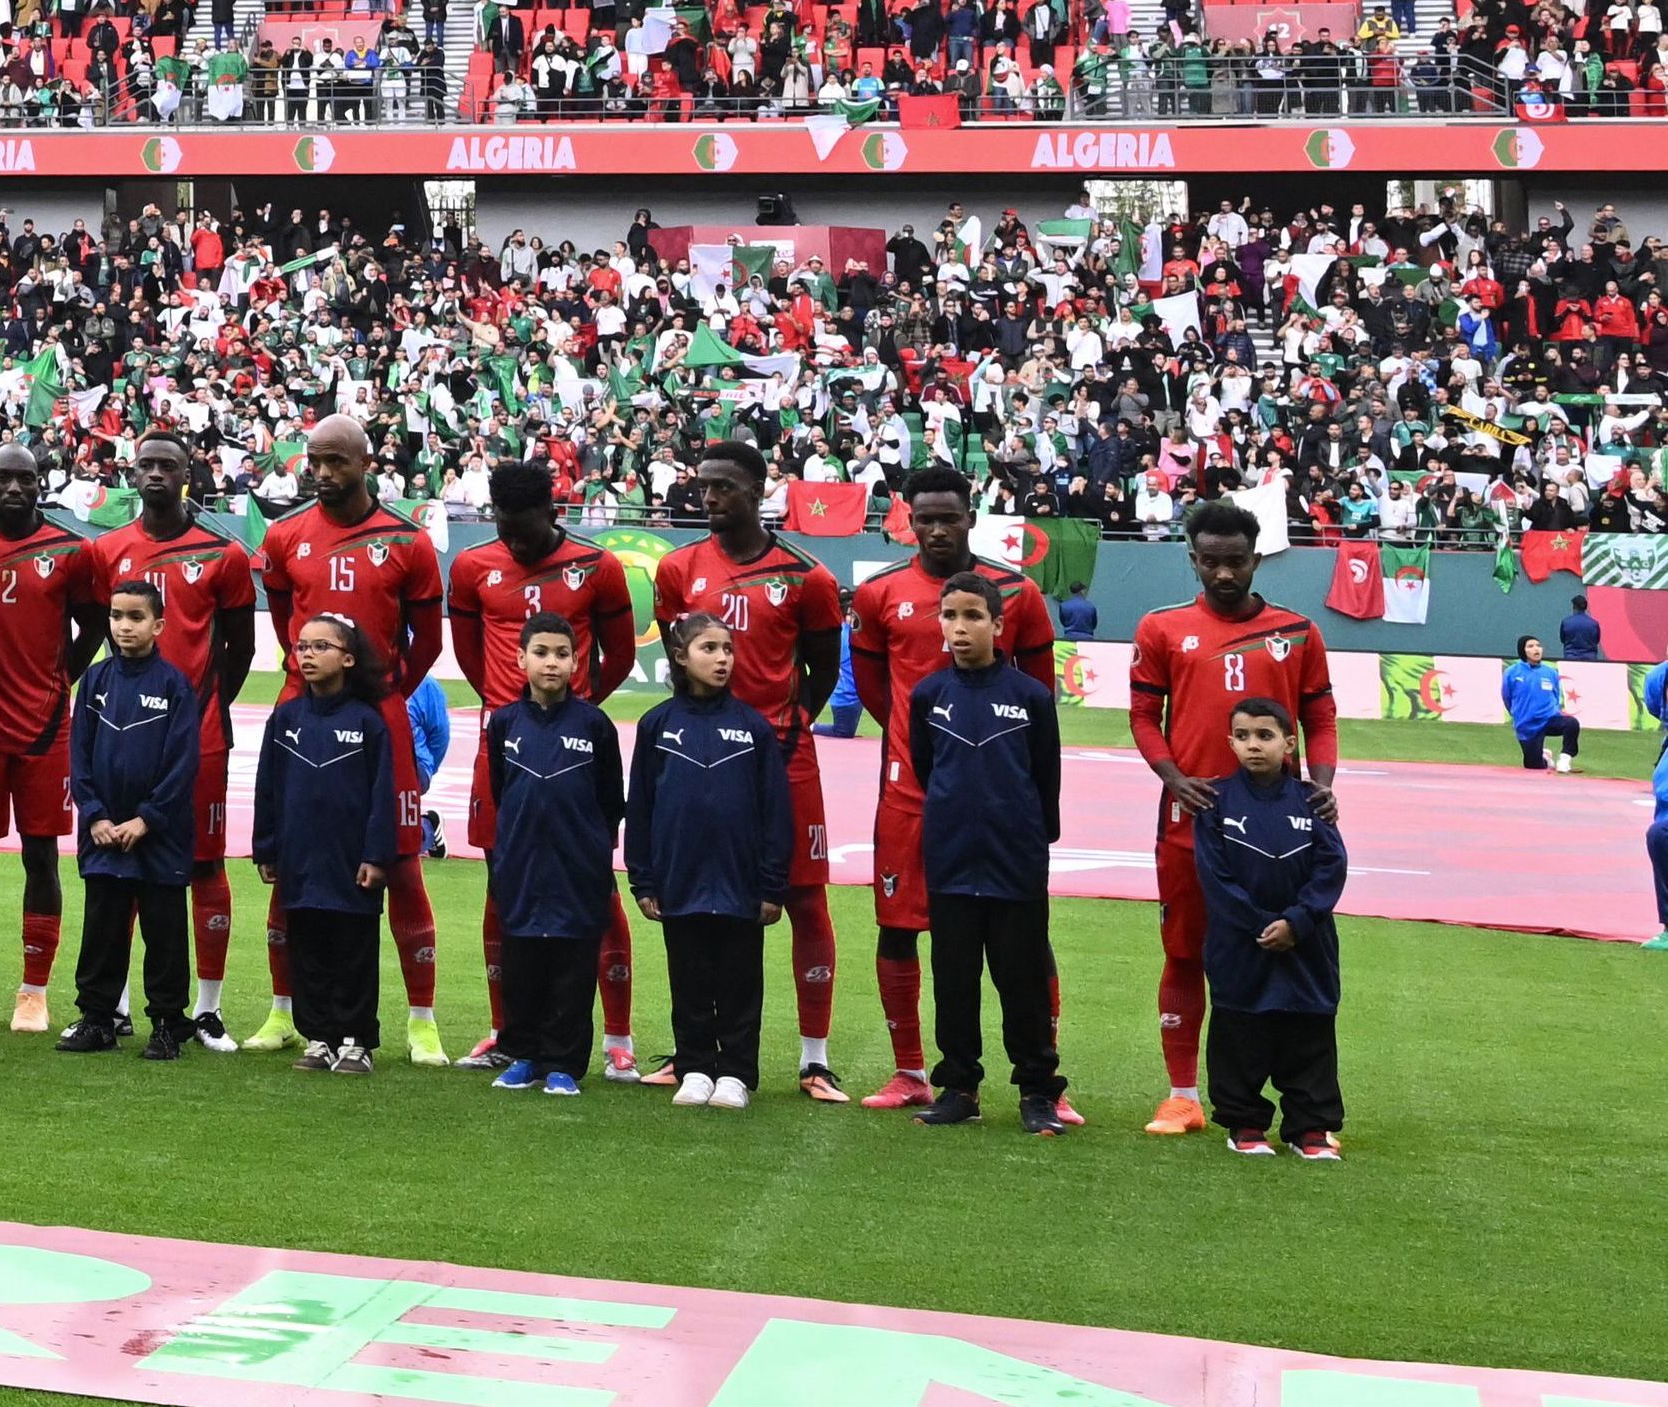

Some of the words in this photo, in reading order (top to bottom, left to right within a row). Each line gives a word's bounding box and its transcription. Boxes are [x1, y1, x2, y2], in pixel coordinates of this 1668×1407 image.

[446, 136, 577, 169] ALGERIA
[1030, 133, 1176, 168] ALGERIA
[1, 570, 17, 604] 2
[328, 556, 355, 592] 15
[524, 584, 541, 618] 3
[722, 593, 750, 632] 20
[1224, 653, 1244, 692] 8
[140, 694, 168, 710] VISA
[992, 703, 1030, 720] VISA
[561, 736, 593, 753] VISA
[718, 728, 754, 743] VISA
[399, 790, 418, 827] 15
[1287, 816, 1313, 831] VIS
[807, 824, 828, 862] 20
